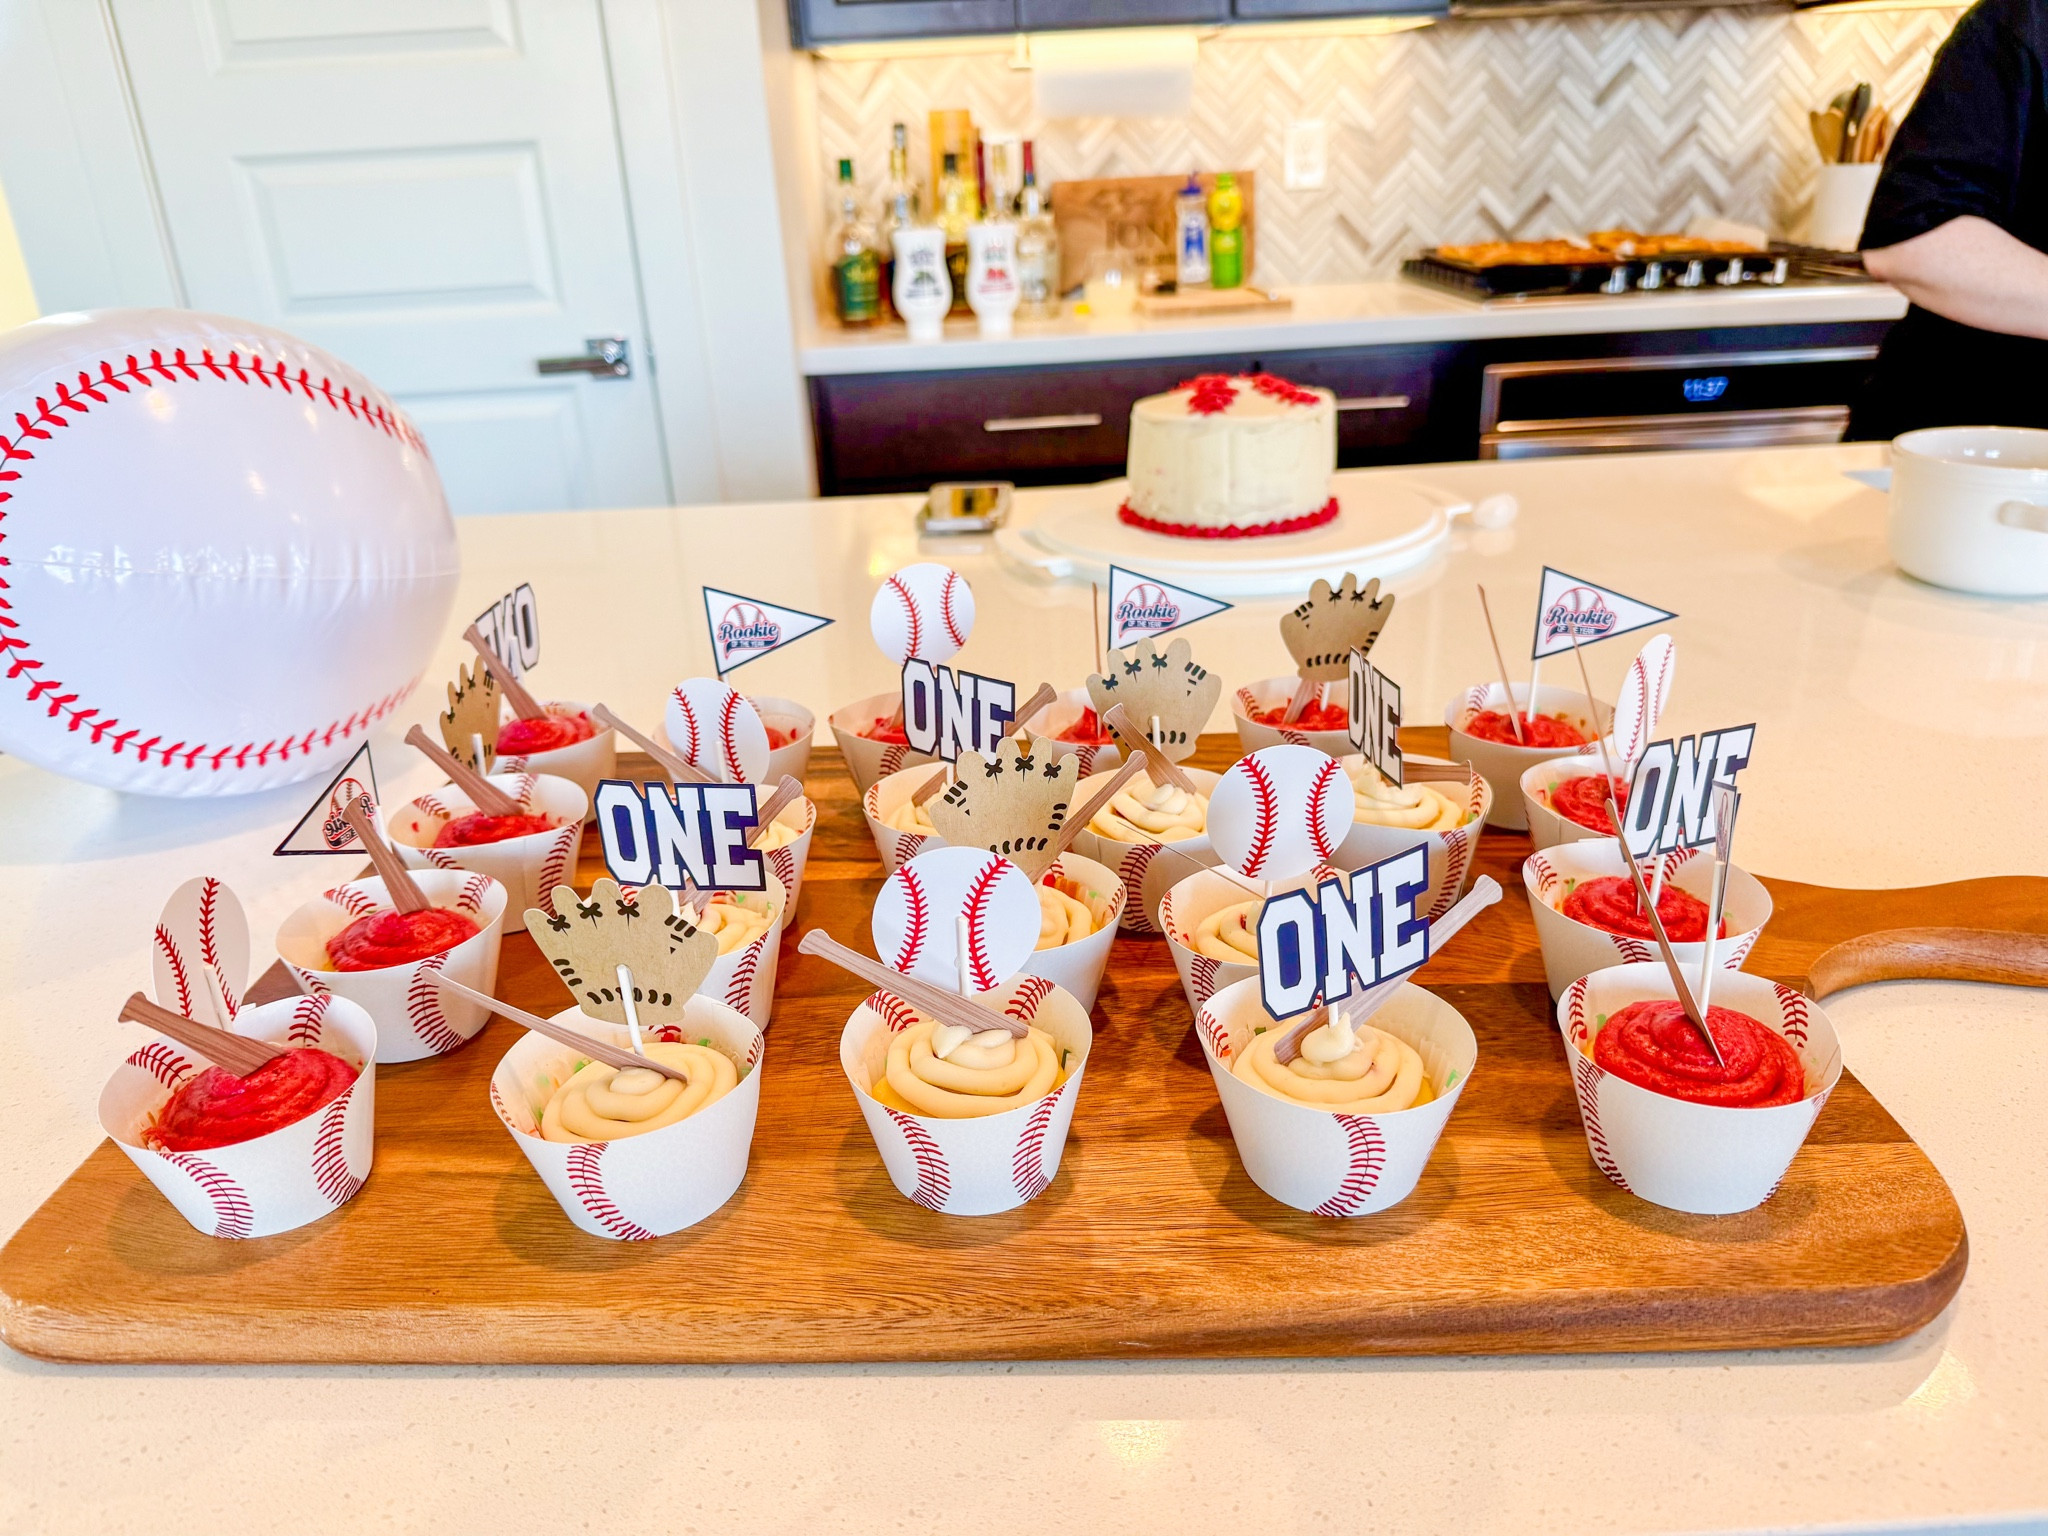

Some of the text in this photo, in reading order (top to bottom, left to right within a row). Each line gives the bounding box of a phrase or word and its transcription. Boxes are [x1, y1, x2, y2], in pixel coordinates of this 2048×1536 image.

[720, 622, 777, 640] Rookie
[1117, 603, 1177, 620] Rookie
[1546, 607, 1614, 626] Rookie
[902, 657, 1015, 765] ONE
[1348, 646, 1401, 789] ONE
[595, 780, 766, 891] ONE
[1257, 842, 1429, 1021] ONE
